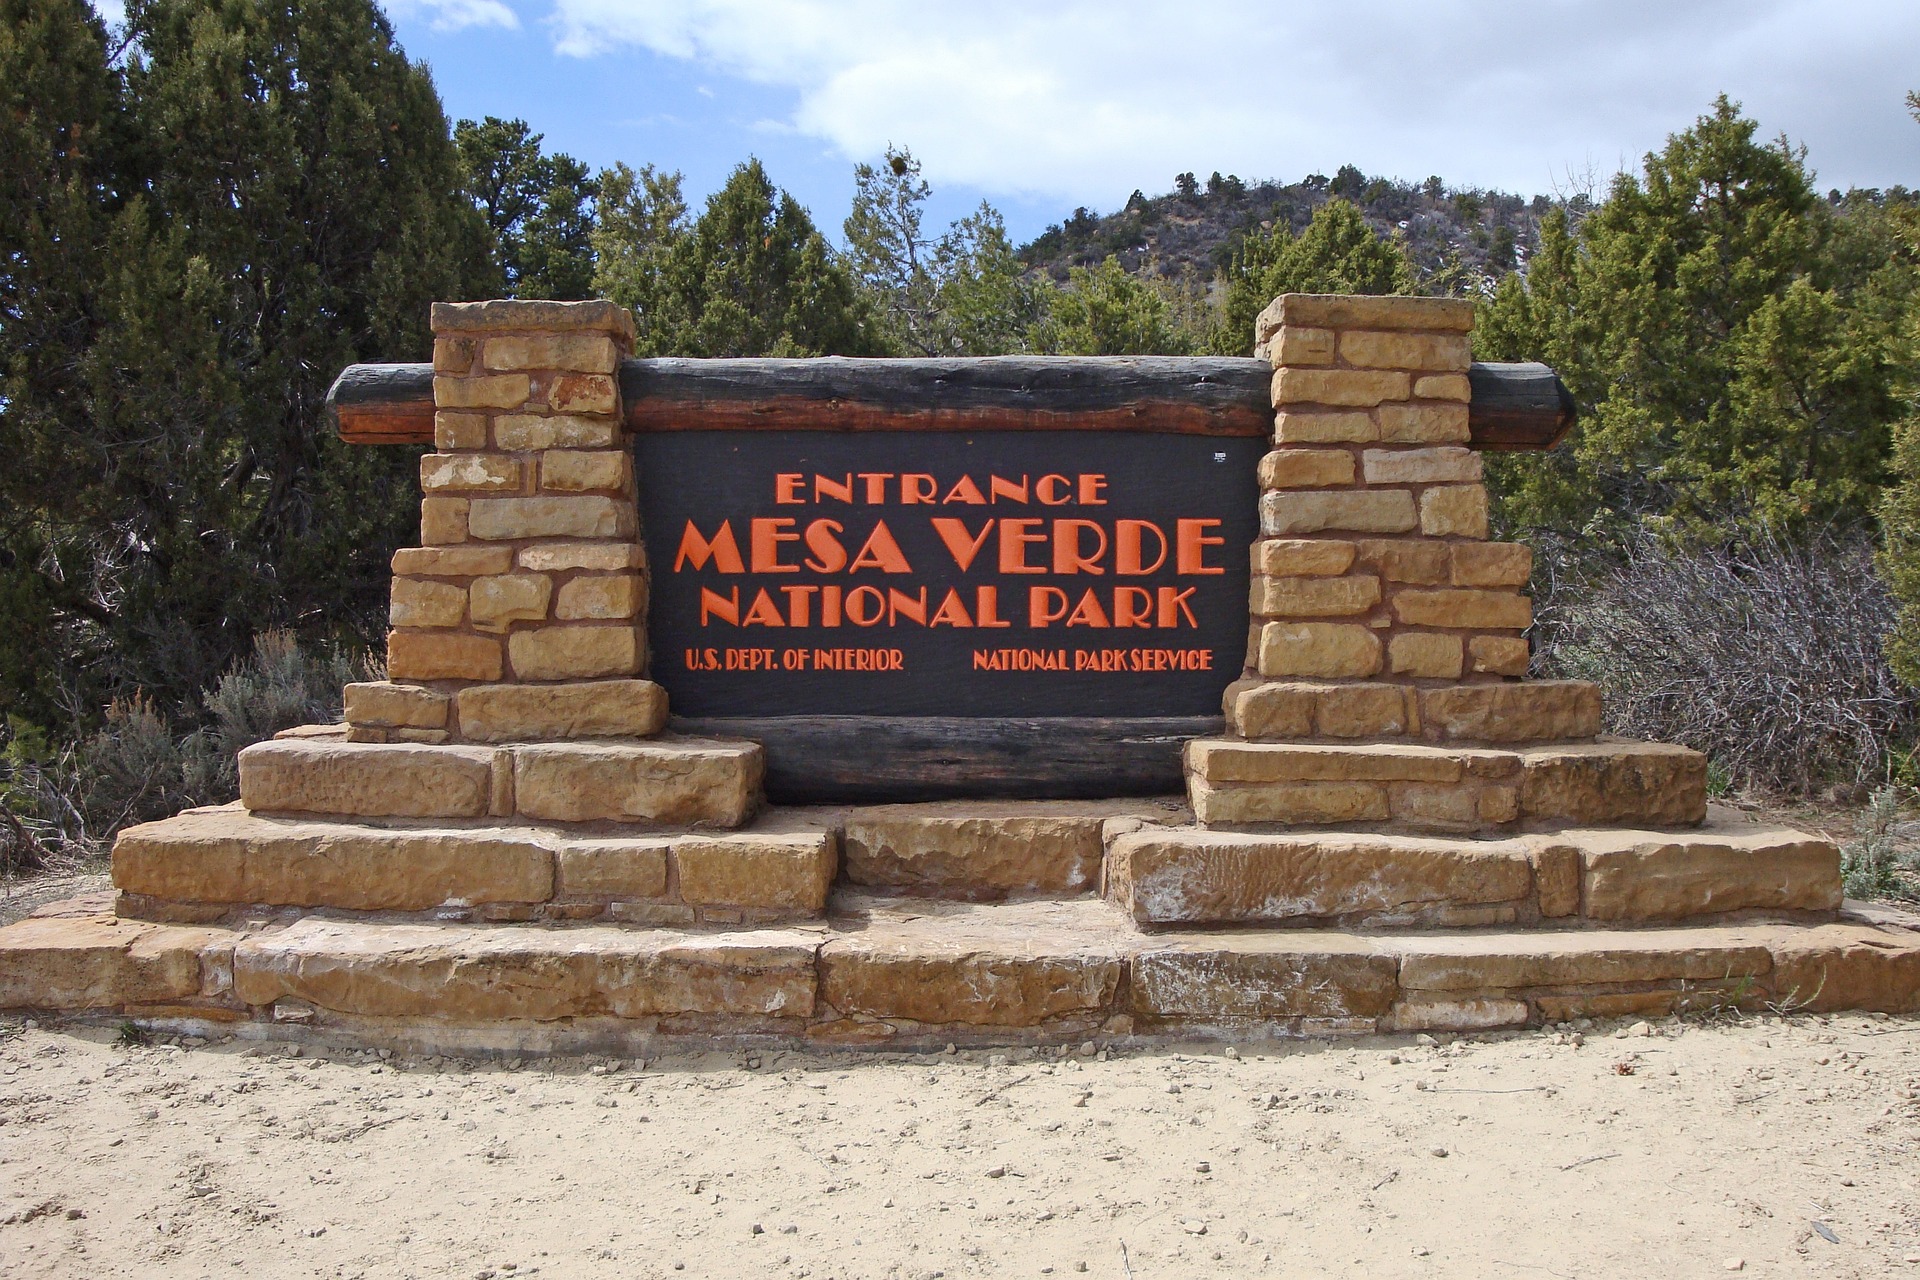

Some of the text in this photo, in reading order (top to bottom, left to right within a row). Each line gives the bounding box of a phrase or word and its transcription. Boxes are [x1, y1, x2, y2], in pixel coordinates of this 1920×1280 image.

[775, 472, 1108, 506] ENTRANCE
[673, 517, 1226, 576] MESA VERDE
[701, 584, 1198, 629] NATIONAL PARK
[685, 648, 904, 671] U.S. DEPT. OF INTERIOR
[973, 648, 1213, 672] NATIONAL PARK SERVICE
